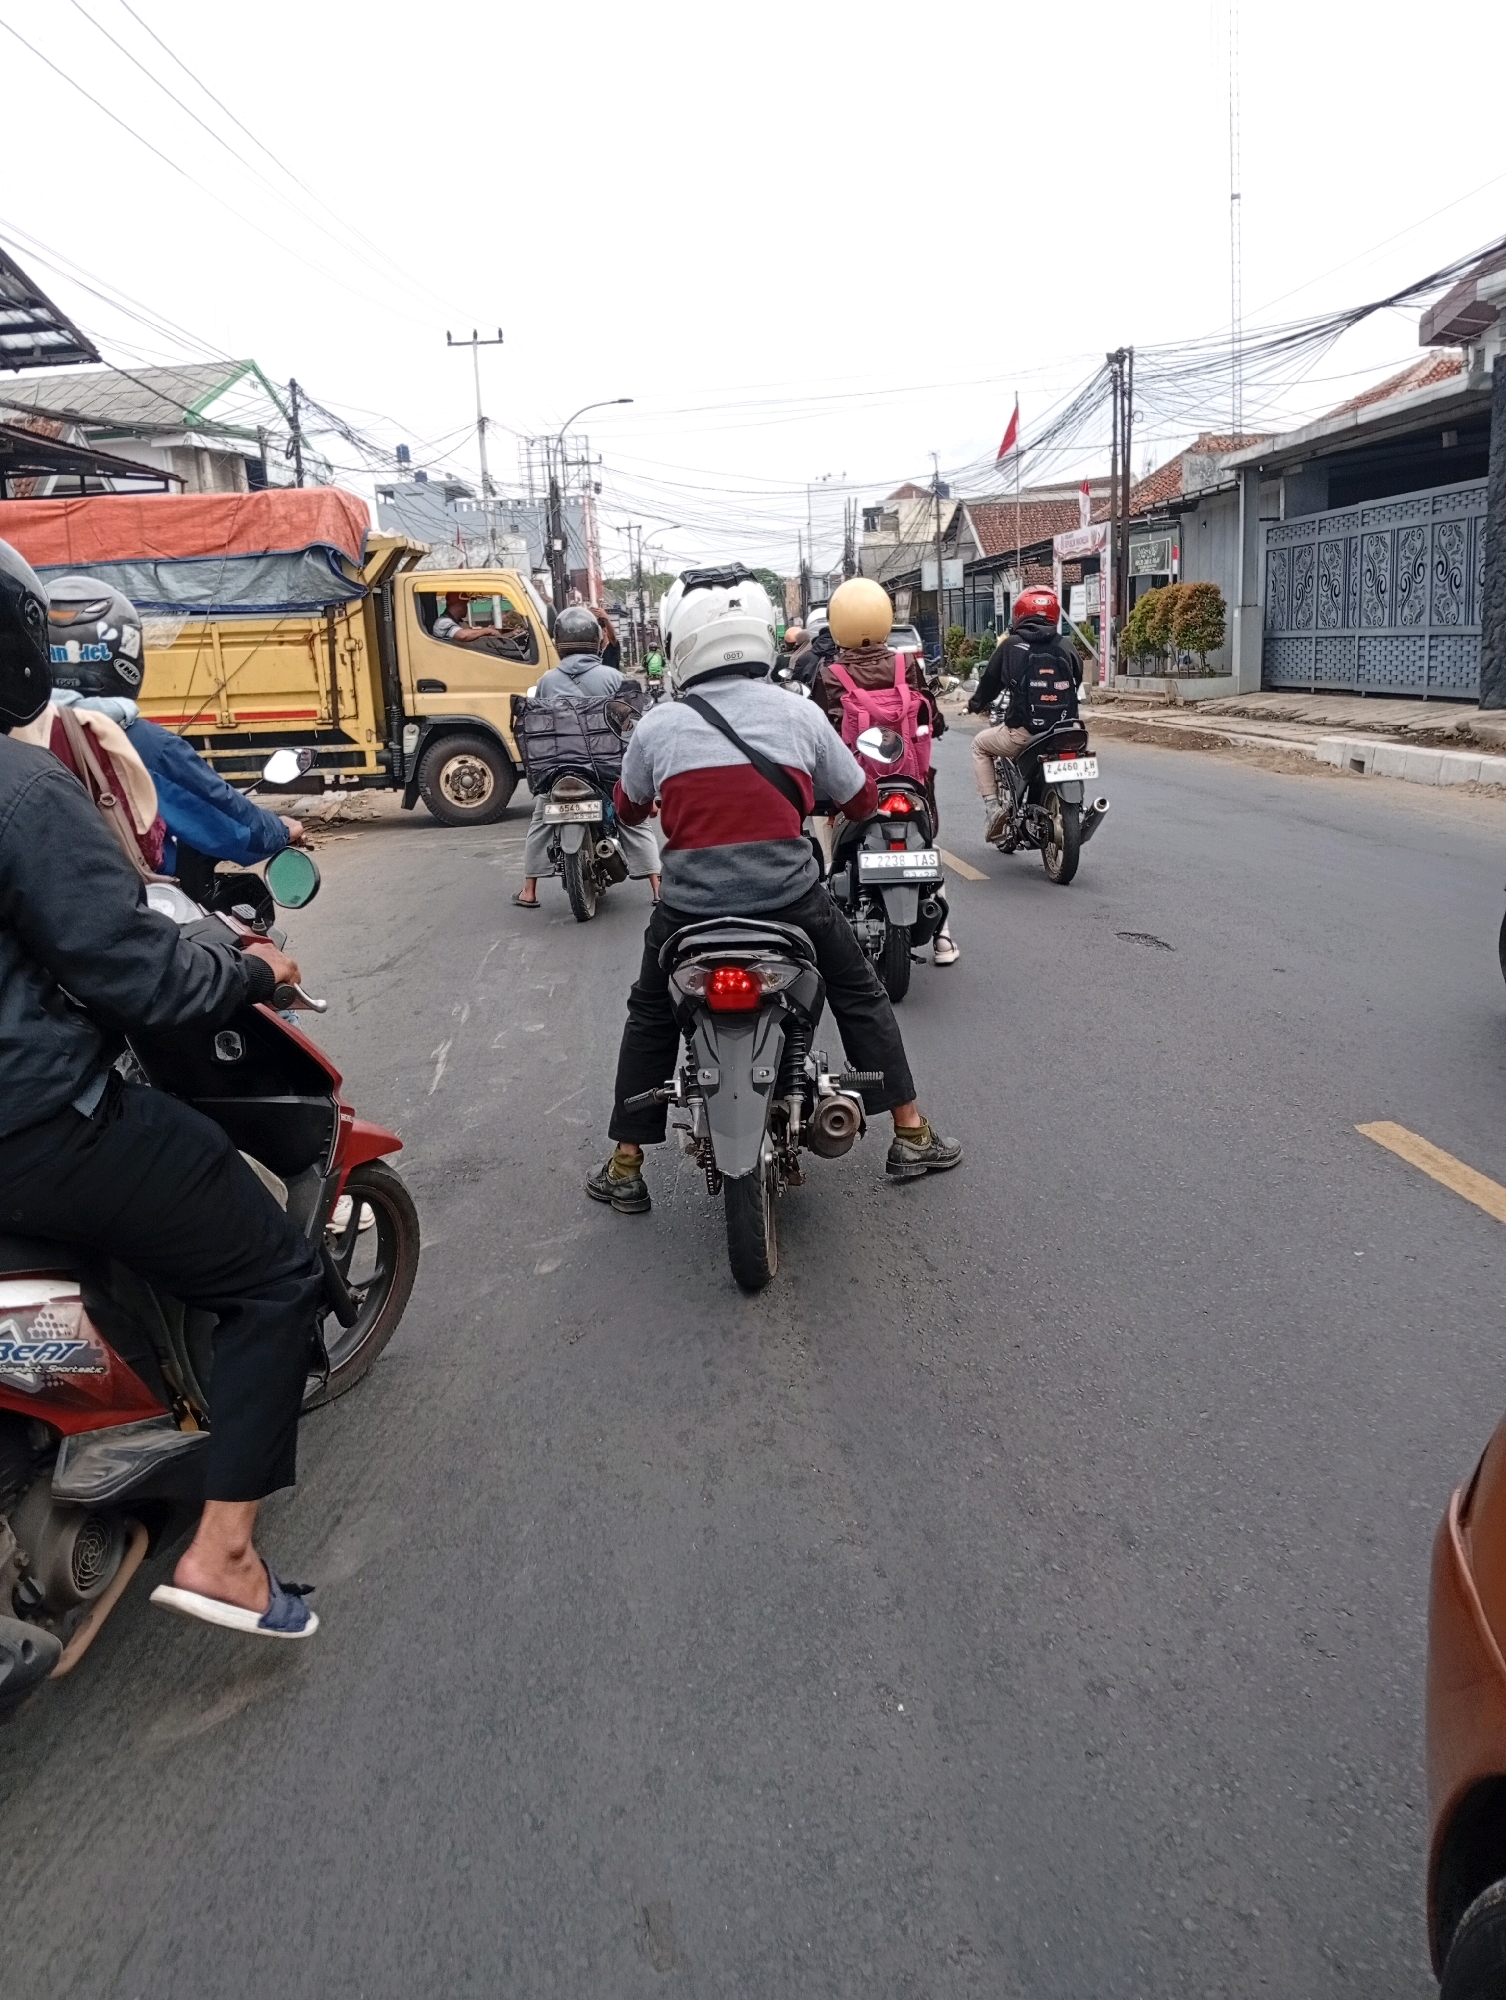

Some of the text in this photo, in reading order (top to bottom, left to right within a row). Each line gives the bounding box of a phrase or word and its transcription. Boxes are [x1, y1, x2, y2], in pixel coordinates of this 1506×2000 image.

[726, 652, 741, 660] DOT
[118, 662, 139, 679] INK
[1047, 764, 1052, 774] Z
[863, 854, 936, 868] Z 2238 TAS
